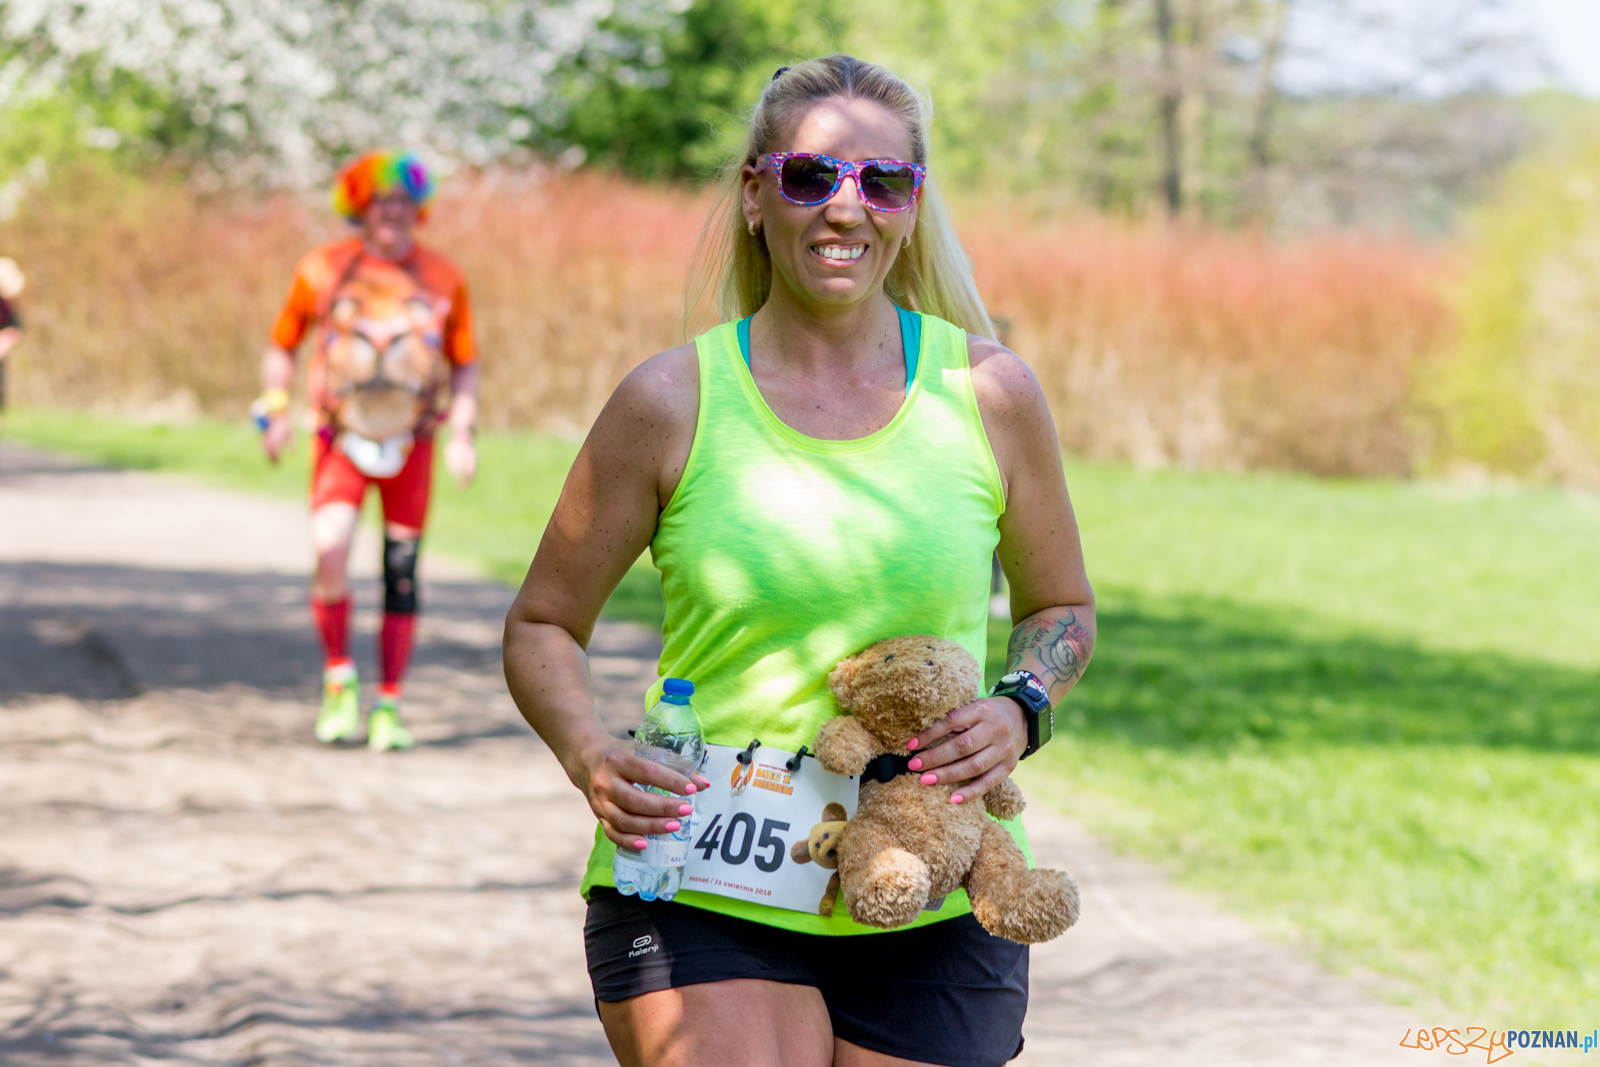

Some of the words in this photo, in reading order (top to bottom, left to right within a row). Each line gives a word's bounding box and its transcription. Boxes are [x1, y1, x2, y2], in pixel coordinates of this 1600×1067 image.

[693, 811, 791, 873] 405
[714, 878, 722, 886] 21
[754, 888, 772, 897] 2018
[628, 942, 659, 959] Kalenji
